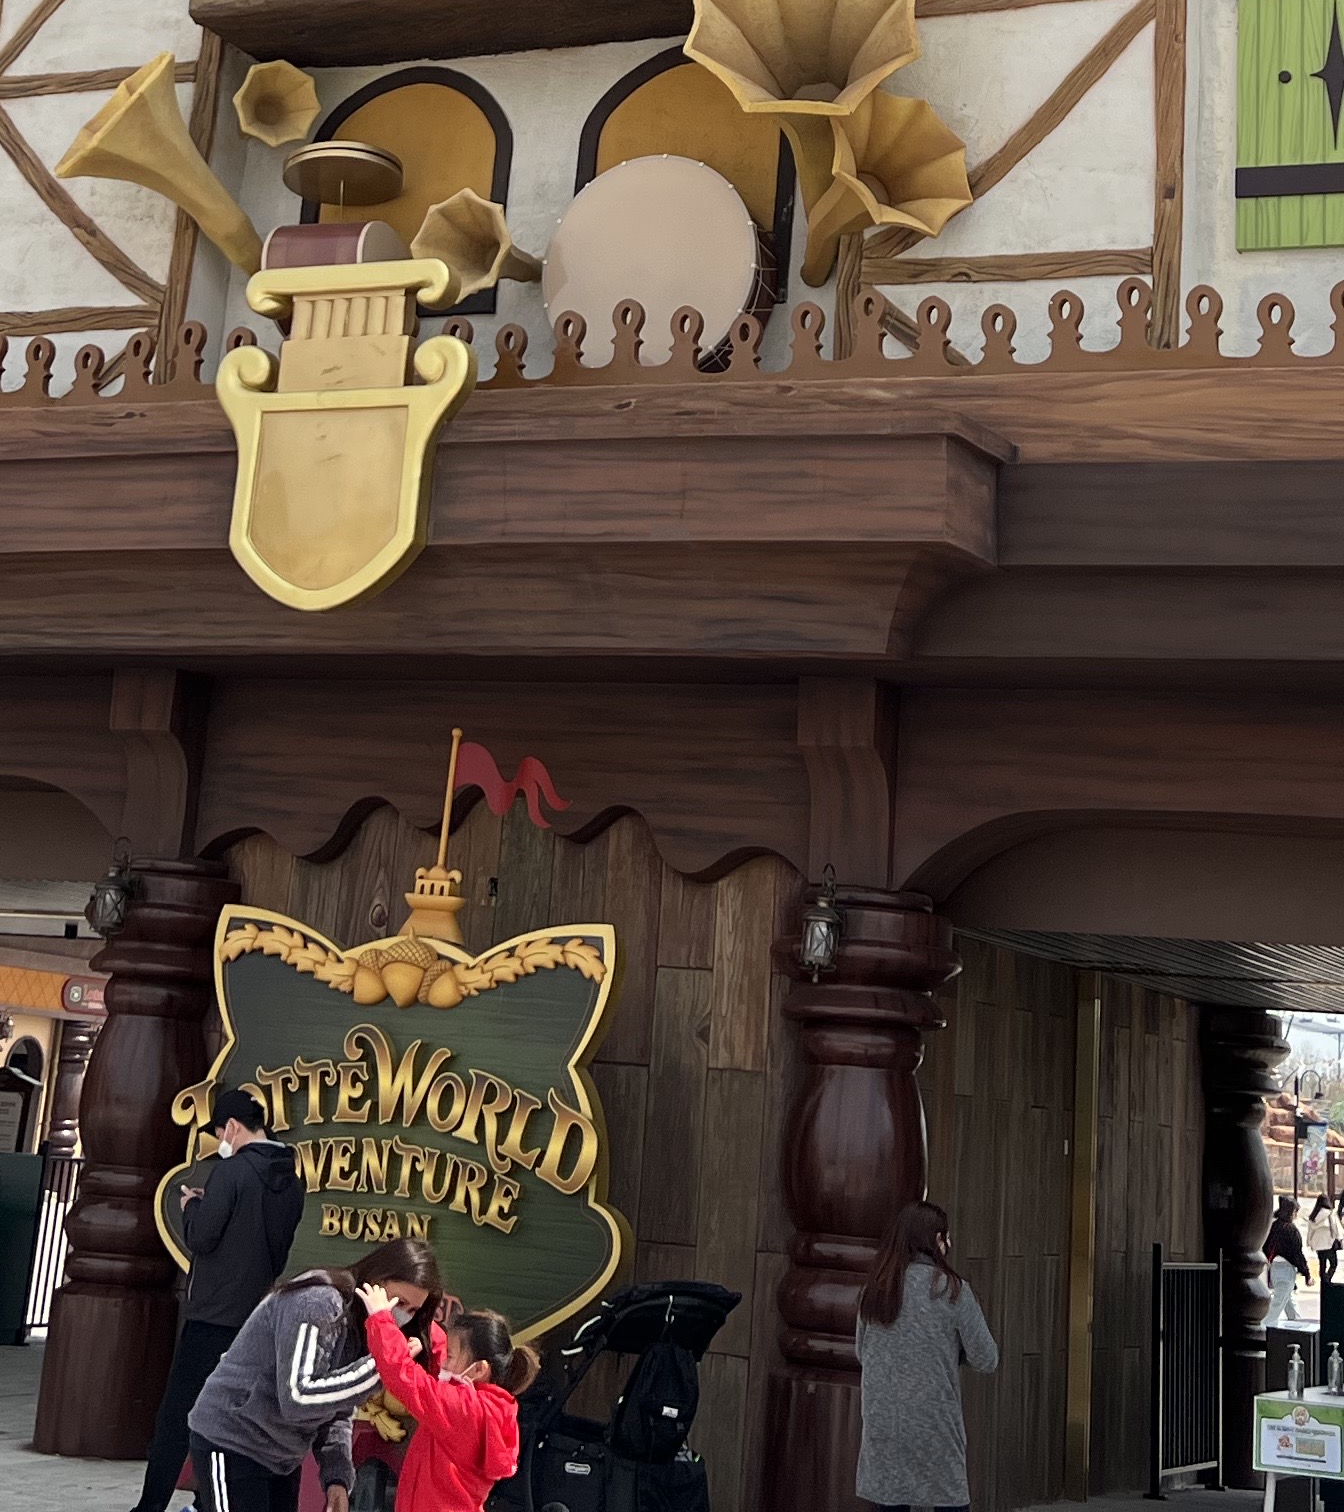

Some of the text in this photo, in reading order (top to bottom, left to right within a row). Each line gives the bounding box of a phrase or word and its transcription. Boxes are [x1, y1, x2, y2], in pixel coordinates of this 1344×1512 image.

[171, 1023, 599, 1195] LTTE WORLD
[293, 1135, 521, 1235] VENTURE
[319, 1203, 432, 1243] BUSAN
